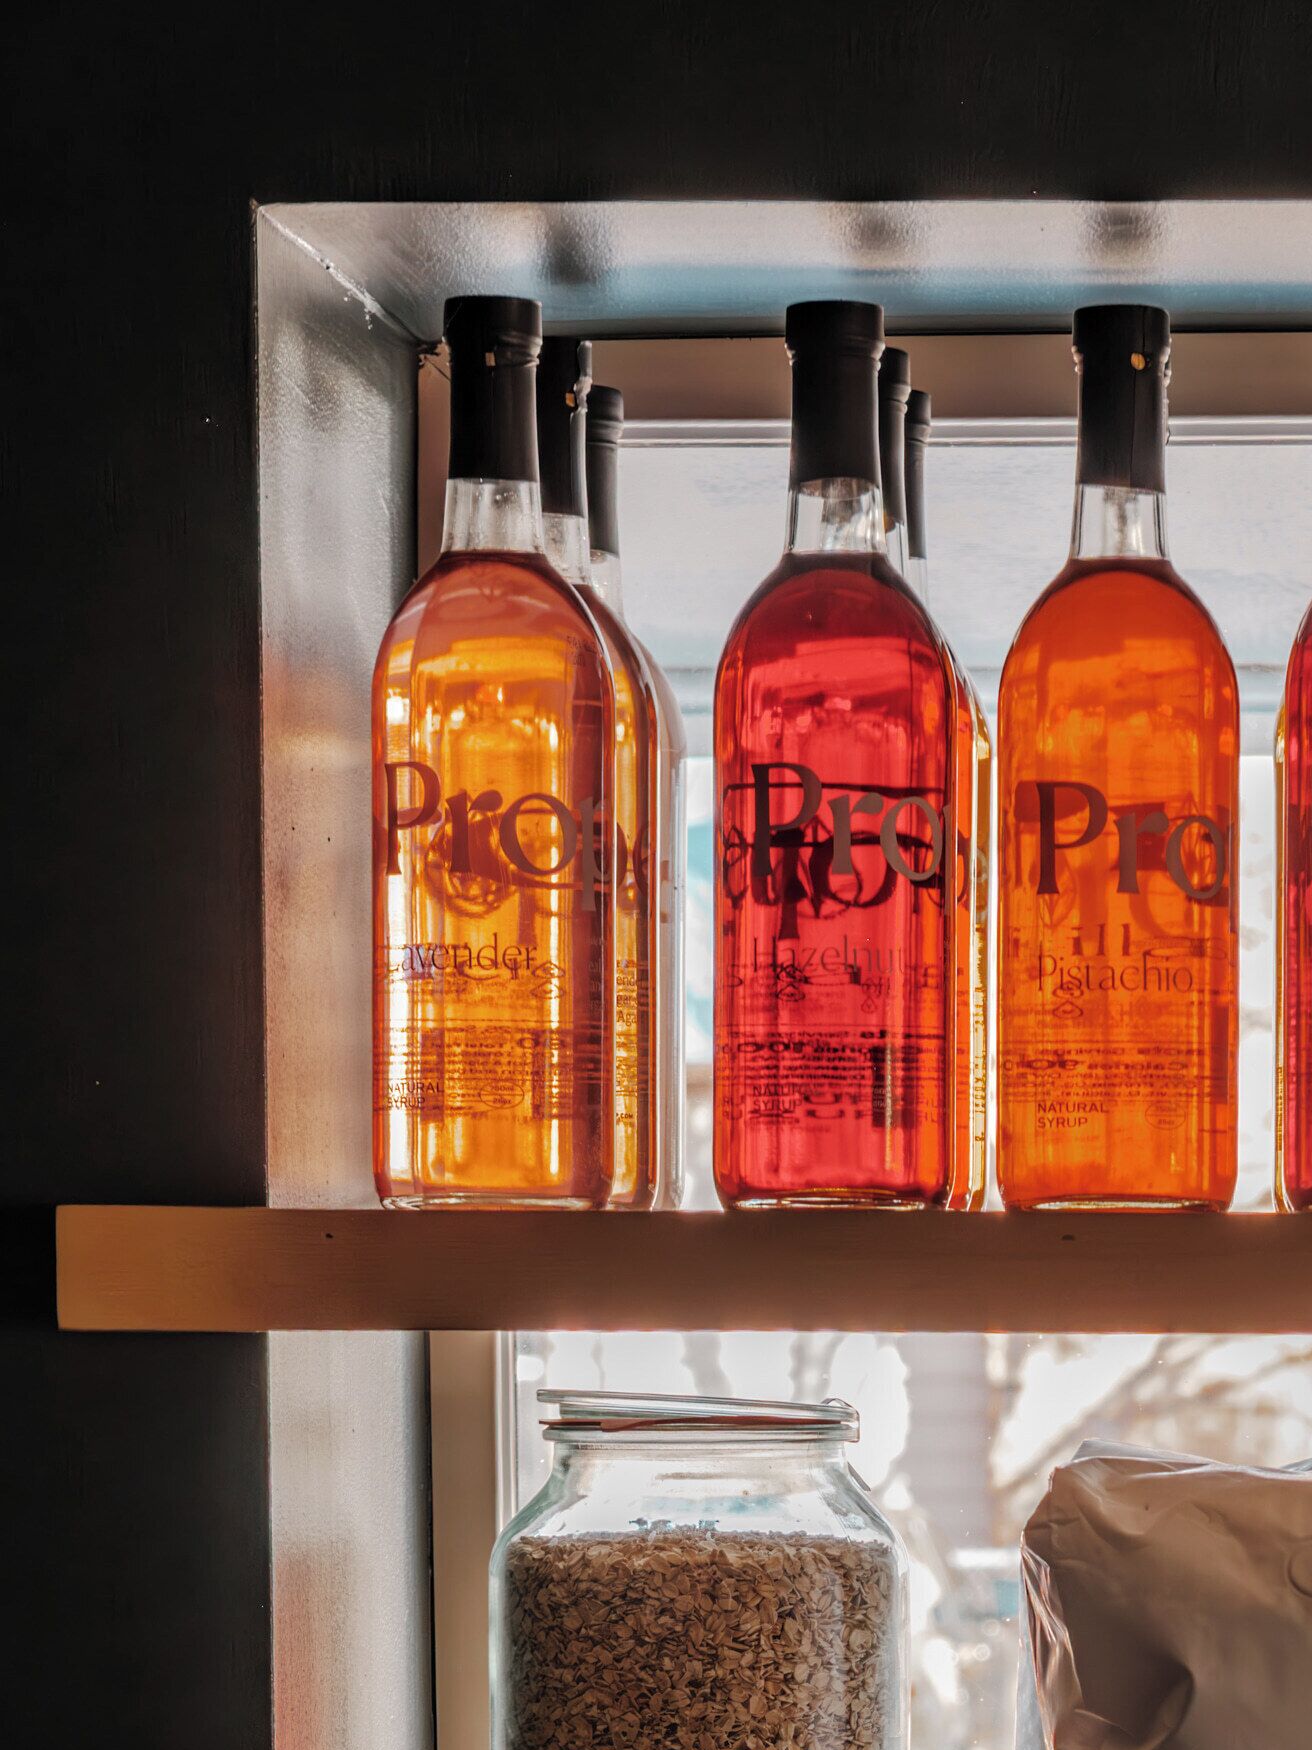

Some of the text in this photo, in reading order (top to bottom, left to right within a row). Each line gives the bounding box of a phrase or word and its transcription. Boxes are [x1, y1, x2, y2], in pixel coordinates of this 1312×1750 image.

[1036, 780, 1236, 934] Pro
[1037, 952, 1194, 992] Pistachio
[1037, 1103, 1109, 1113] NATURAL
[1037, 1117, 1088, 1129] SYRUP
